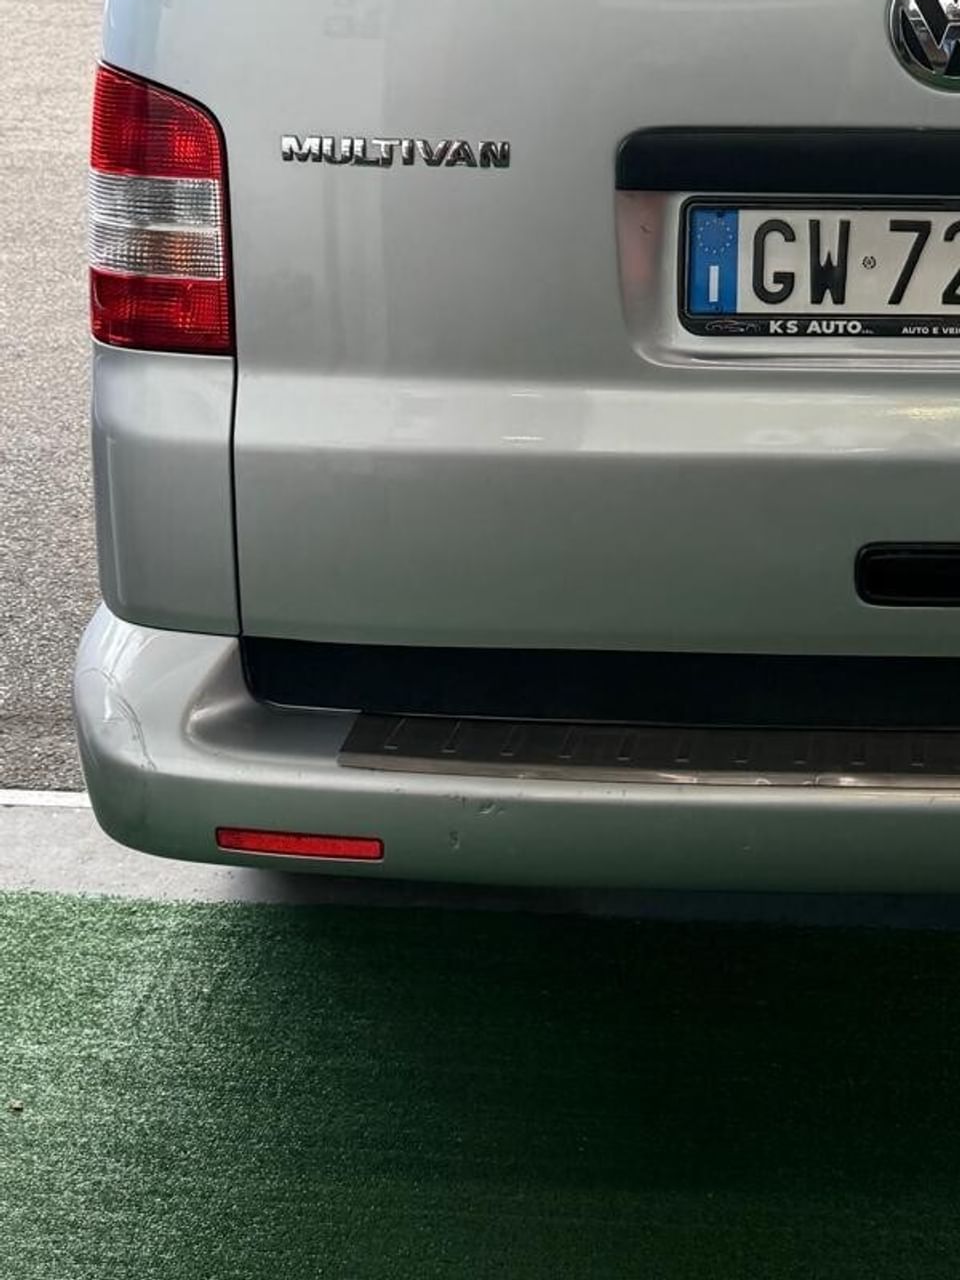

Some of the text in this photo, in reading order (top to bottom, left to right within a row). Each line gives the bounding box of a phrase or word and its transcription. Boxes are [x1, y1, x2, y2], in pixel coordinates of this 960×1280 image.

[281, 135, 511, 169] MULTIVAN
[752, 219, 851, 306] GW
[769, 320, 799, 334] KS
[806, 320, 863, 335] AUTO
[901, 326, 930, 335] AUTO
[932, 326, 939, 335] E
